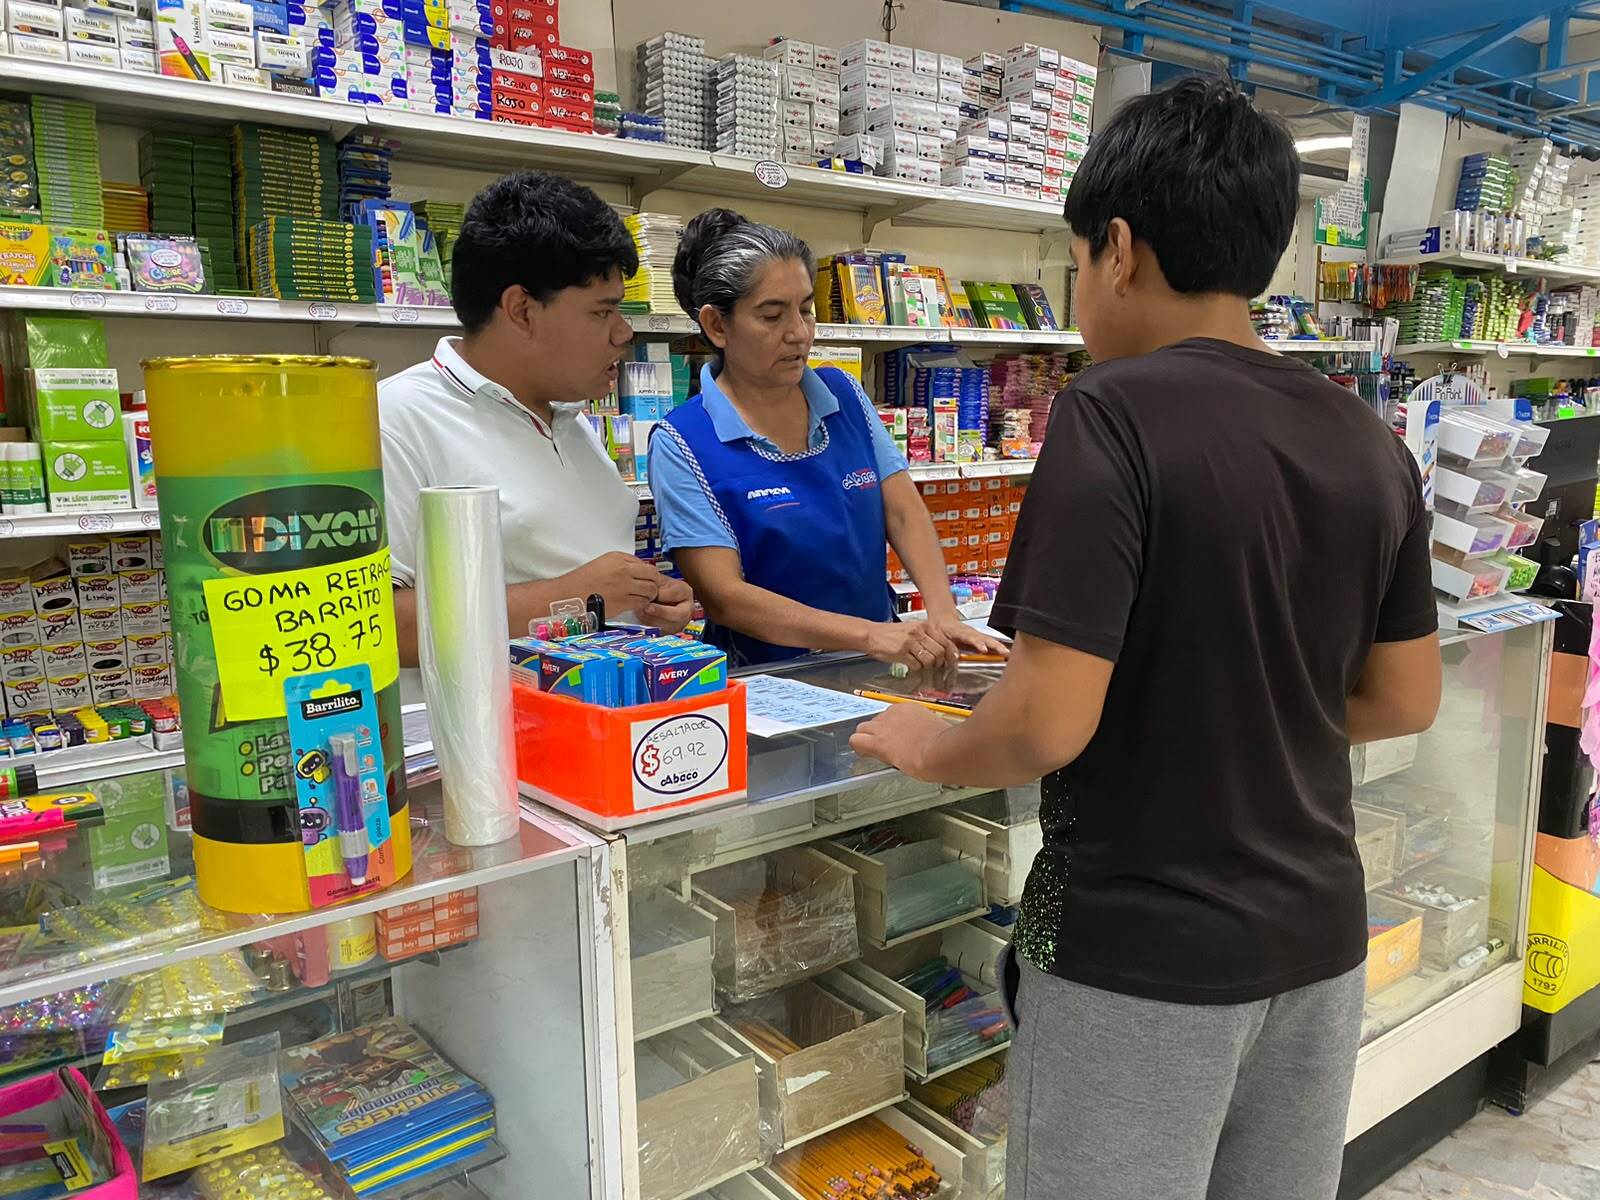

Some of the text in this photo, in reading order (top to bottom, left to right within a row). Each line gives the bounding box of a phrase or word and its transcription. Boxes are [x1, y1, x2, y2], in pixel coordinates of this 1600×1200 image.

[499, 53, 524, 70] ROJO
[496, 92, 526, 109] ROJO
[252, 508, 378, 552] DIXON
[223, 582, 310, 612] GOMA
[275, 587, 382, 633] BARRITO
[658, 669, 690, 681] AVERY
[305, 696, 357, 714] Barrilito
[1532, 978, 1557, 992] 1792
